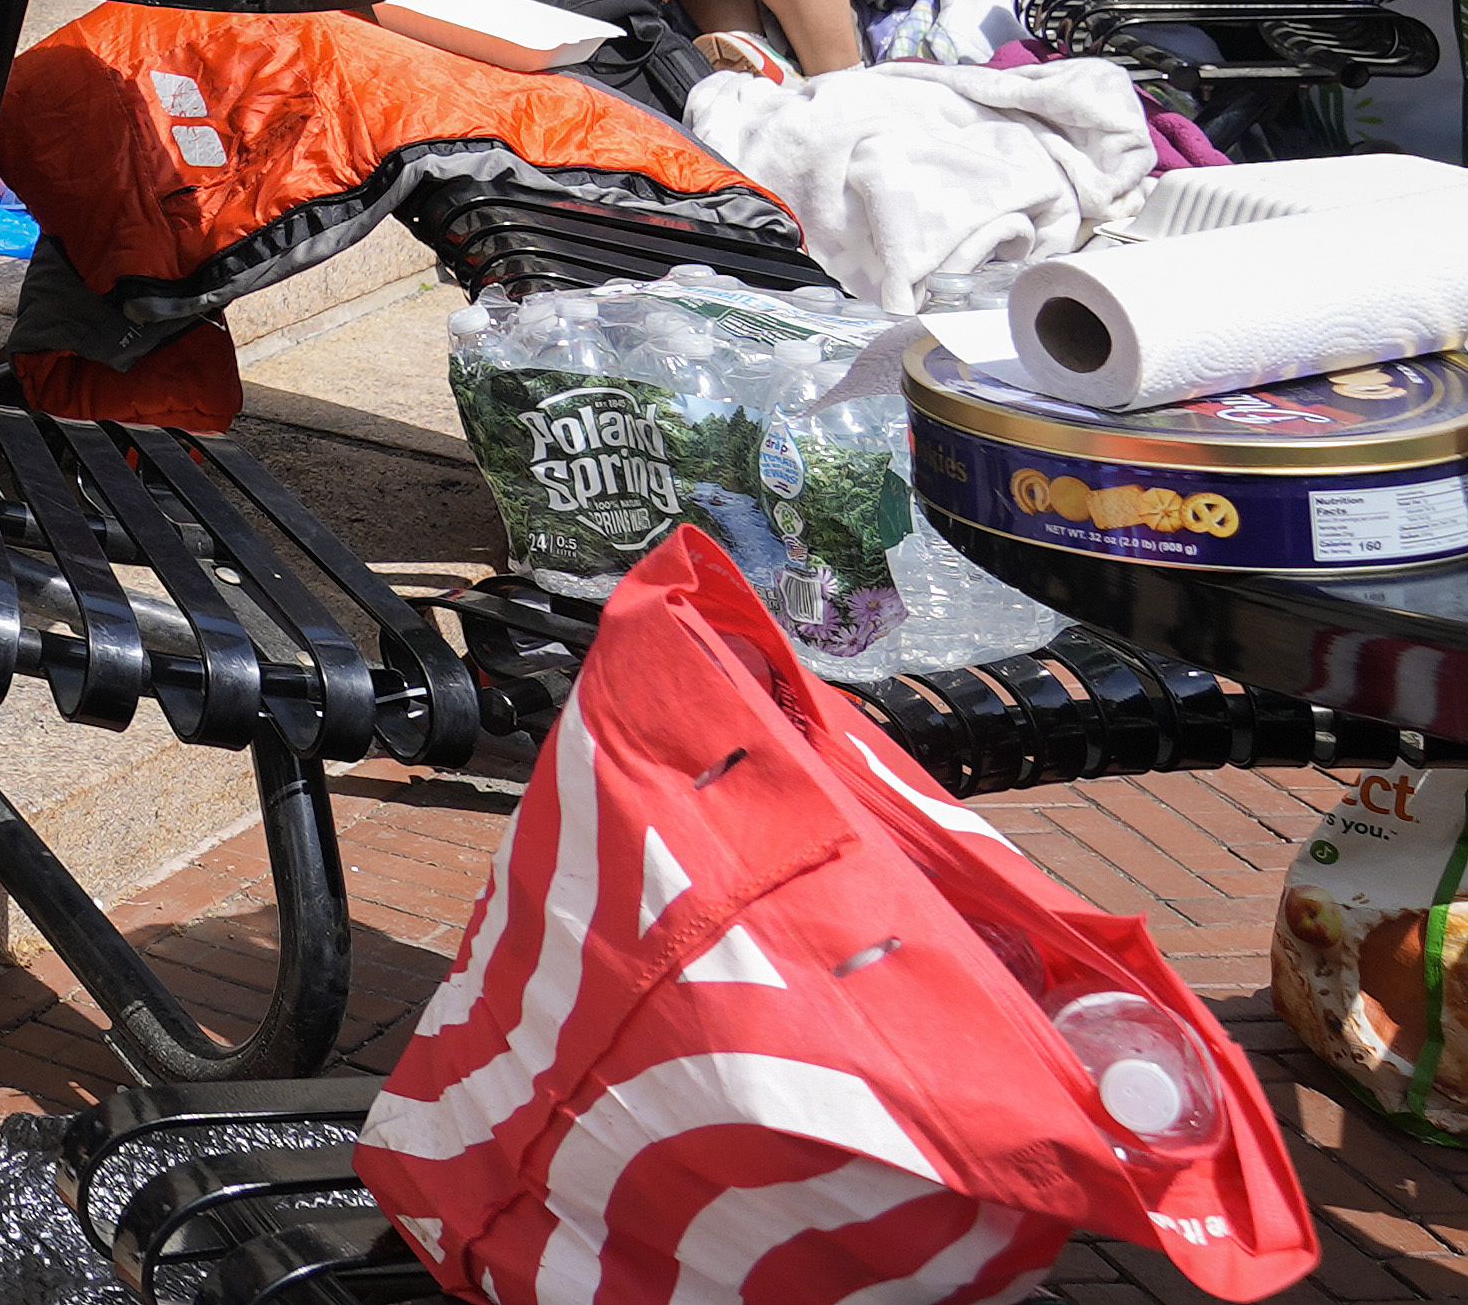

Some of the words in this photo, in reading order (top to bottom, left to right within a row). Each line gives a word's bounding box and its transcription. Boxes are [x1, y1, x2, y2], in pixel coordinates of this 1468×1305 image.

[517, 403, 669, 463] Poland
[530, 448, 684, 514] Spring
[1315, 496, 1365, 505] Nutrition
[1316, 507, 1347, 516] Facts
[528, 532, 547, 552] 24
[555, 537, 578, 550] 0.5
[1045, 523, 1066, 535] NET
[1067, 528, 1086, 540] WT.
[1088, 531, 1102, 543] 32
[1104, 535, 1118, 545] oz
[1118, 536, 1139, 548] (2.0
[1141, 539, 1157, 551] lb)
[1184, 544, 1198, 556] g)
[1319, 540, 1353, 548] Calories
[1358, 540, 1382, 552] 160
